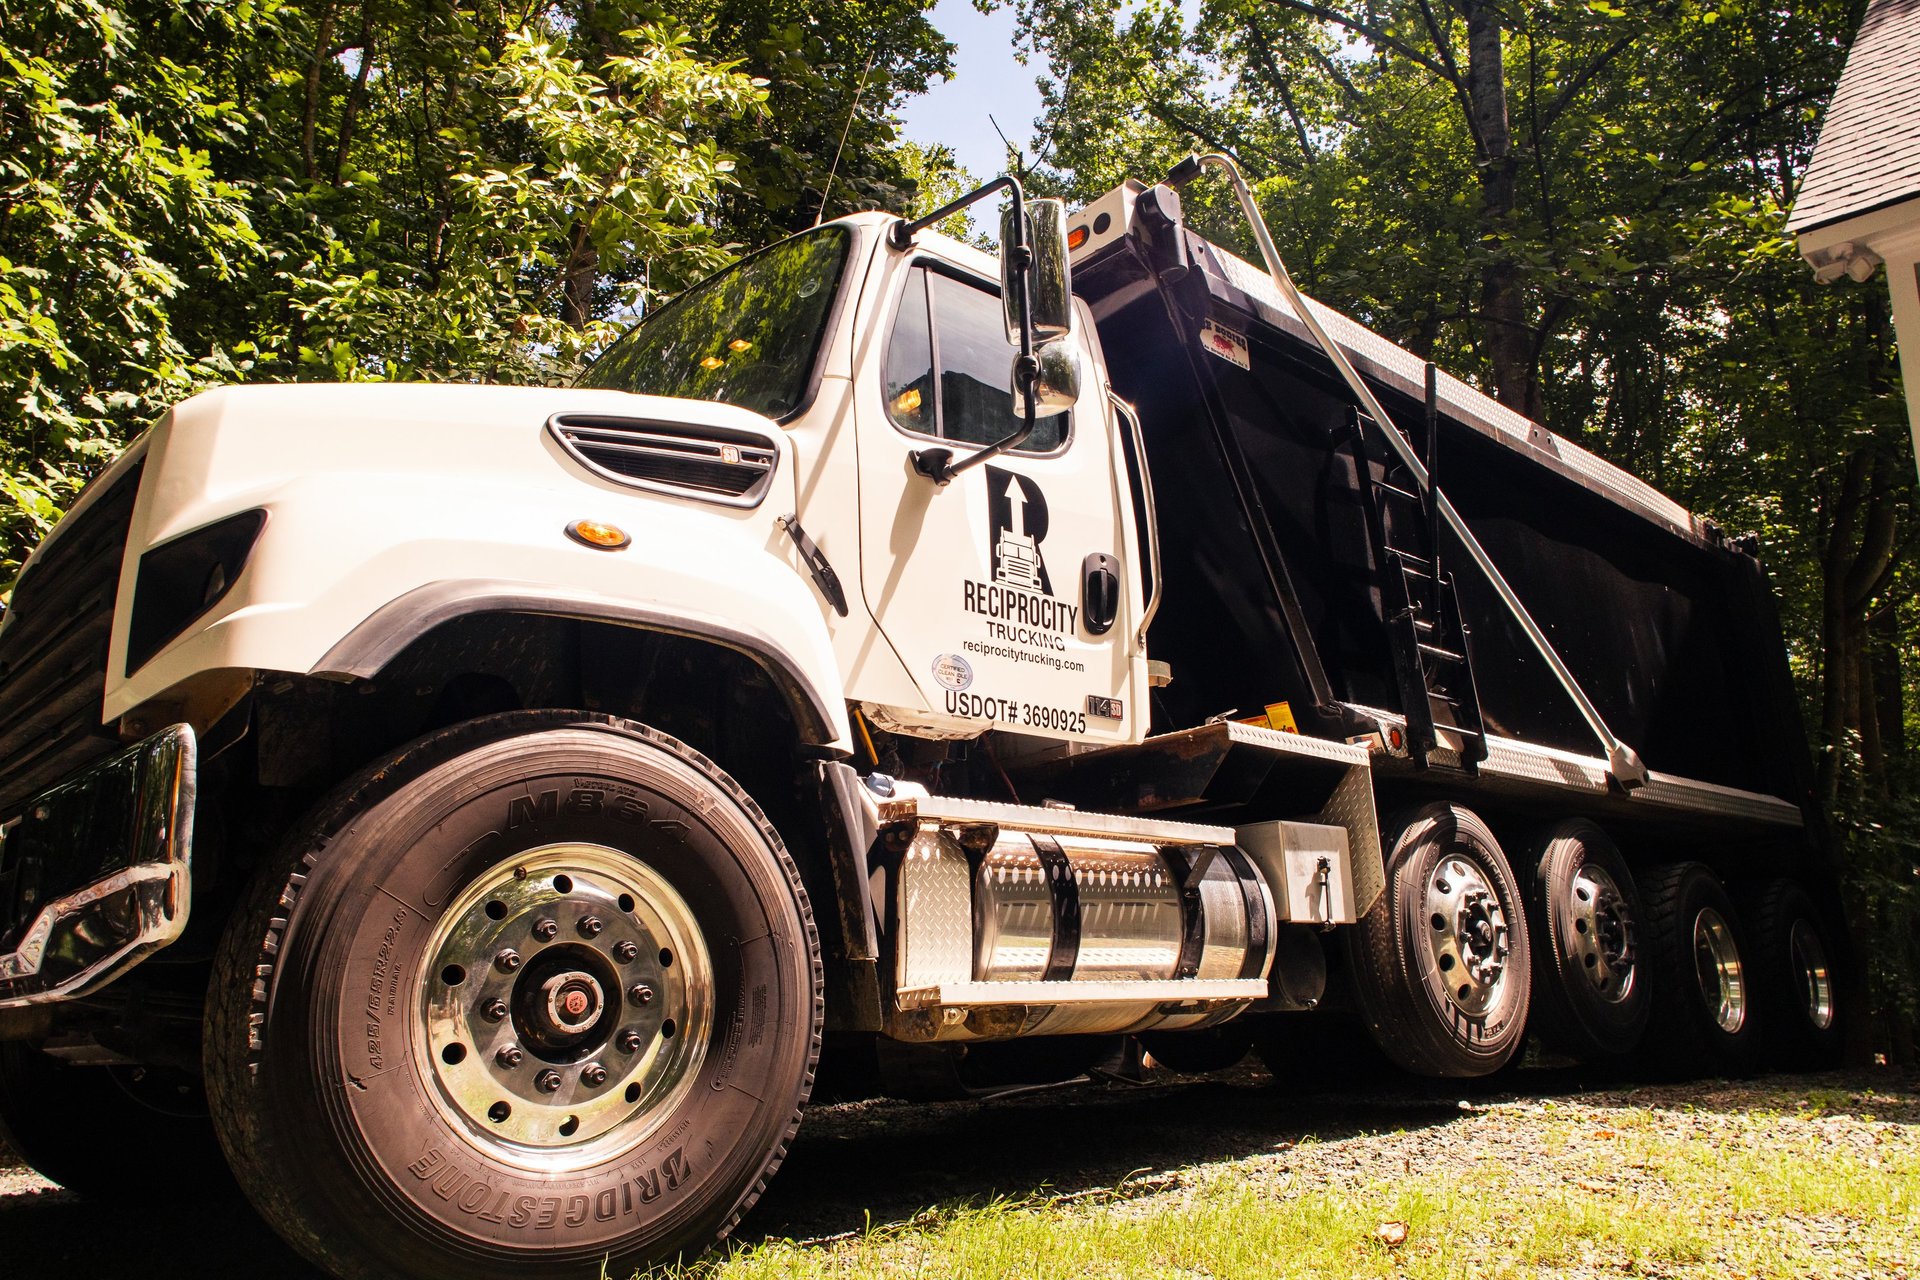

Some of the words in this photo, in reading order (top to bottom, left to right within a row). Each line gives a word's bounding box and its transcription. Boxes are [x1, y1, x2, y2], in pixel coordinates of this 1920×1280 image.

[1214, 324, 1247, 352] BODIES
[964, 580, 1078, 635] RECIPROCITY
[963, 641, 1085, 673] reciprocitytrucking.com
[986, 621, 1065, 652] TRUCKING
[945, 690, 1017, 724] USDOT#
[1023, 704, 1086, 734] 3690925
[366, 906, 407, 1070] 425/65R22.5
[387, 962, 403, 1016] RADIAL
[408, 1147, 693, 1230] BRIDGESTONE
